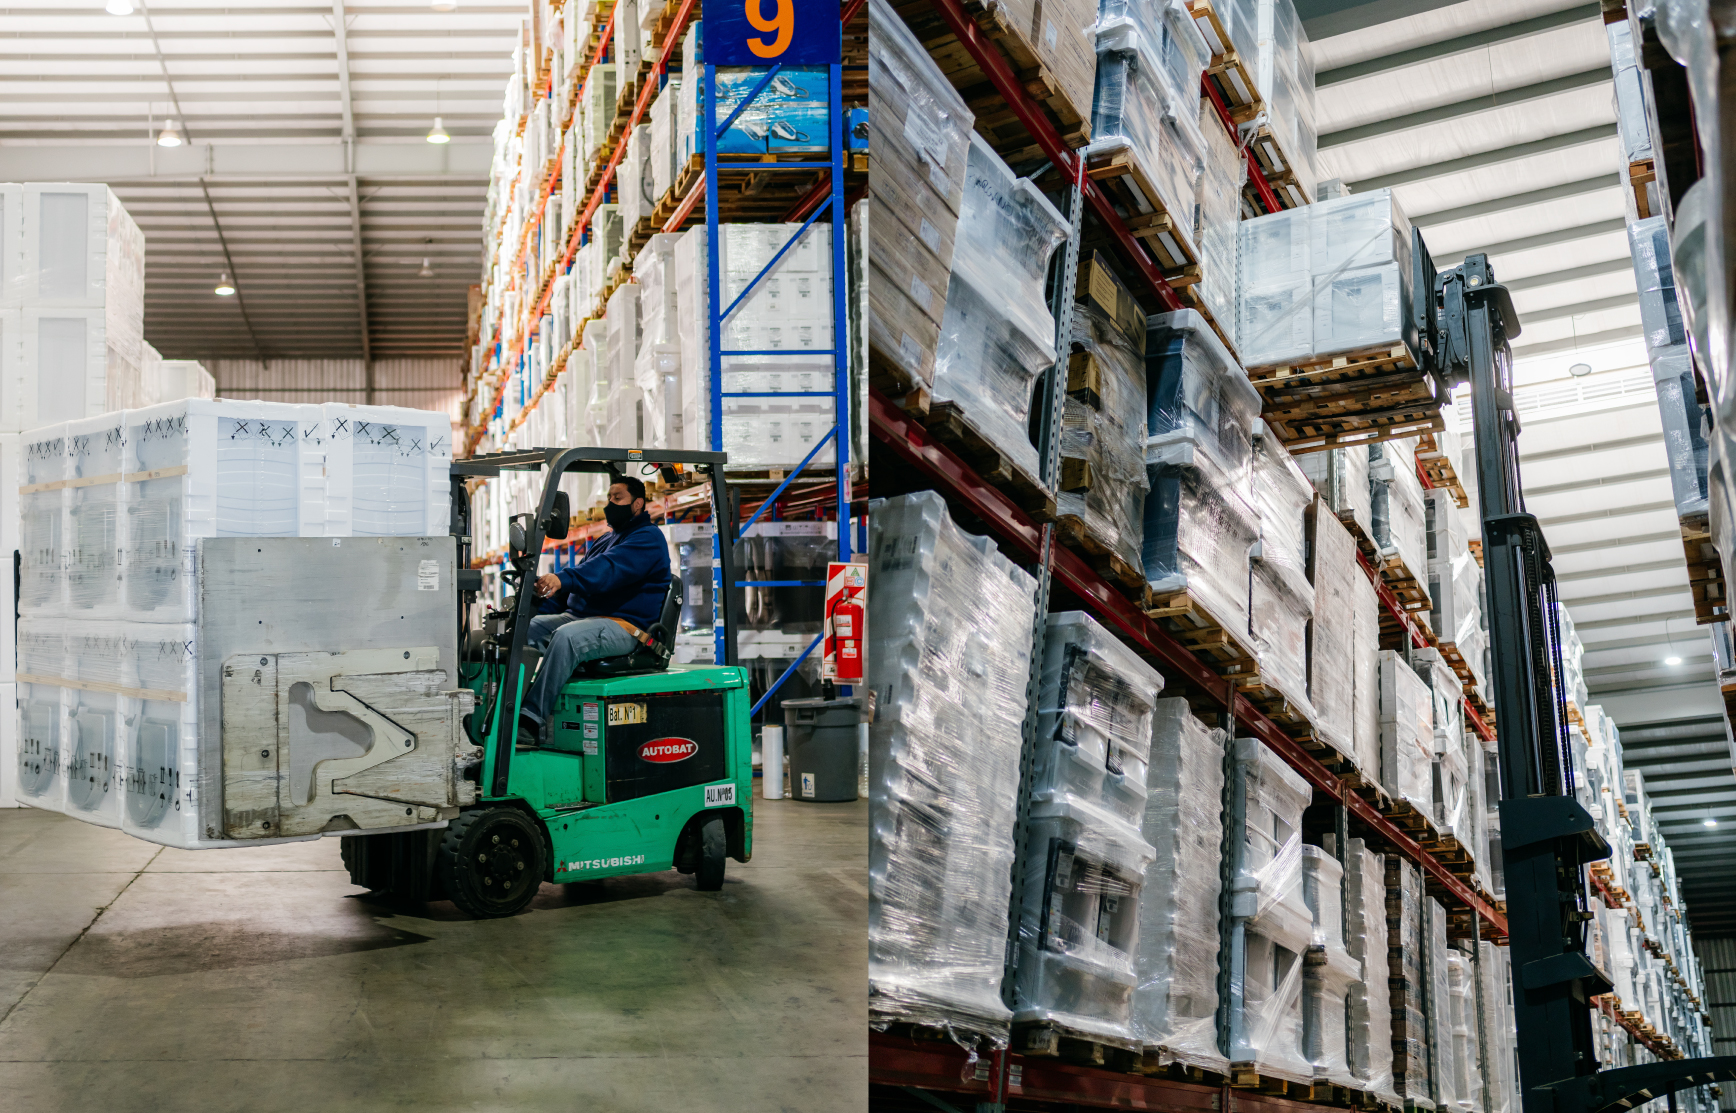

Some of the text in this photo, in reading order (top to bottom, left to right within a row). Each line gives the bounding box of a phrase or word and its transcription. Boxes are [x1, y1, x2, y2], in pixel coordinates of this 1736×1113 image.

[745, 0, 794, 58] 9
[610, 708, 623, 721] Bat.
[642, 744, 693, 757] AUTOBAT
[569, 855, 645, 871] MITSUBISHI
